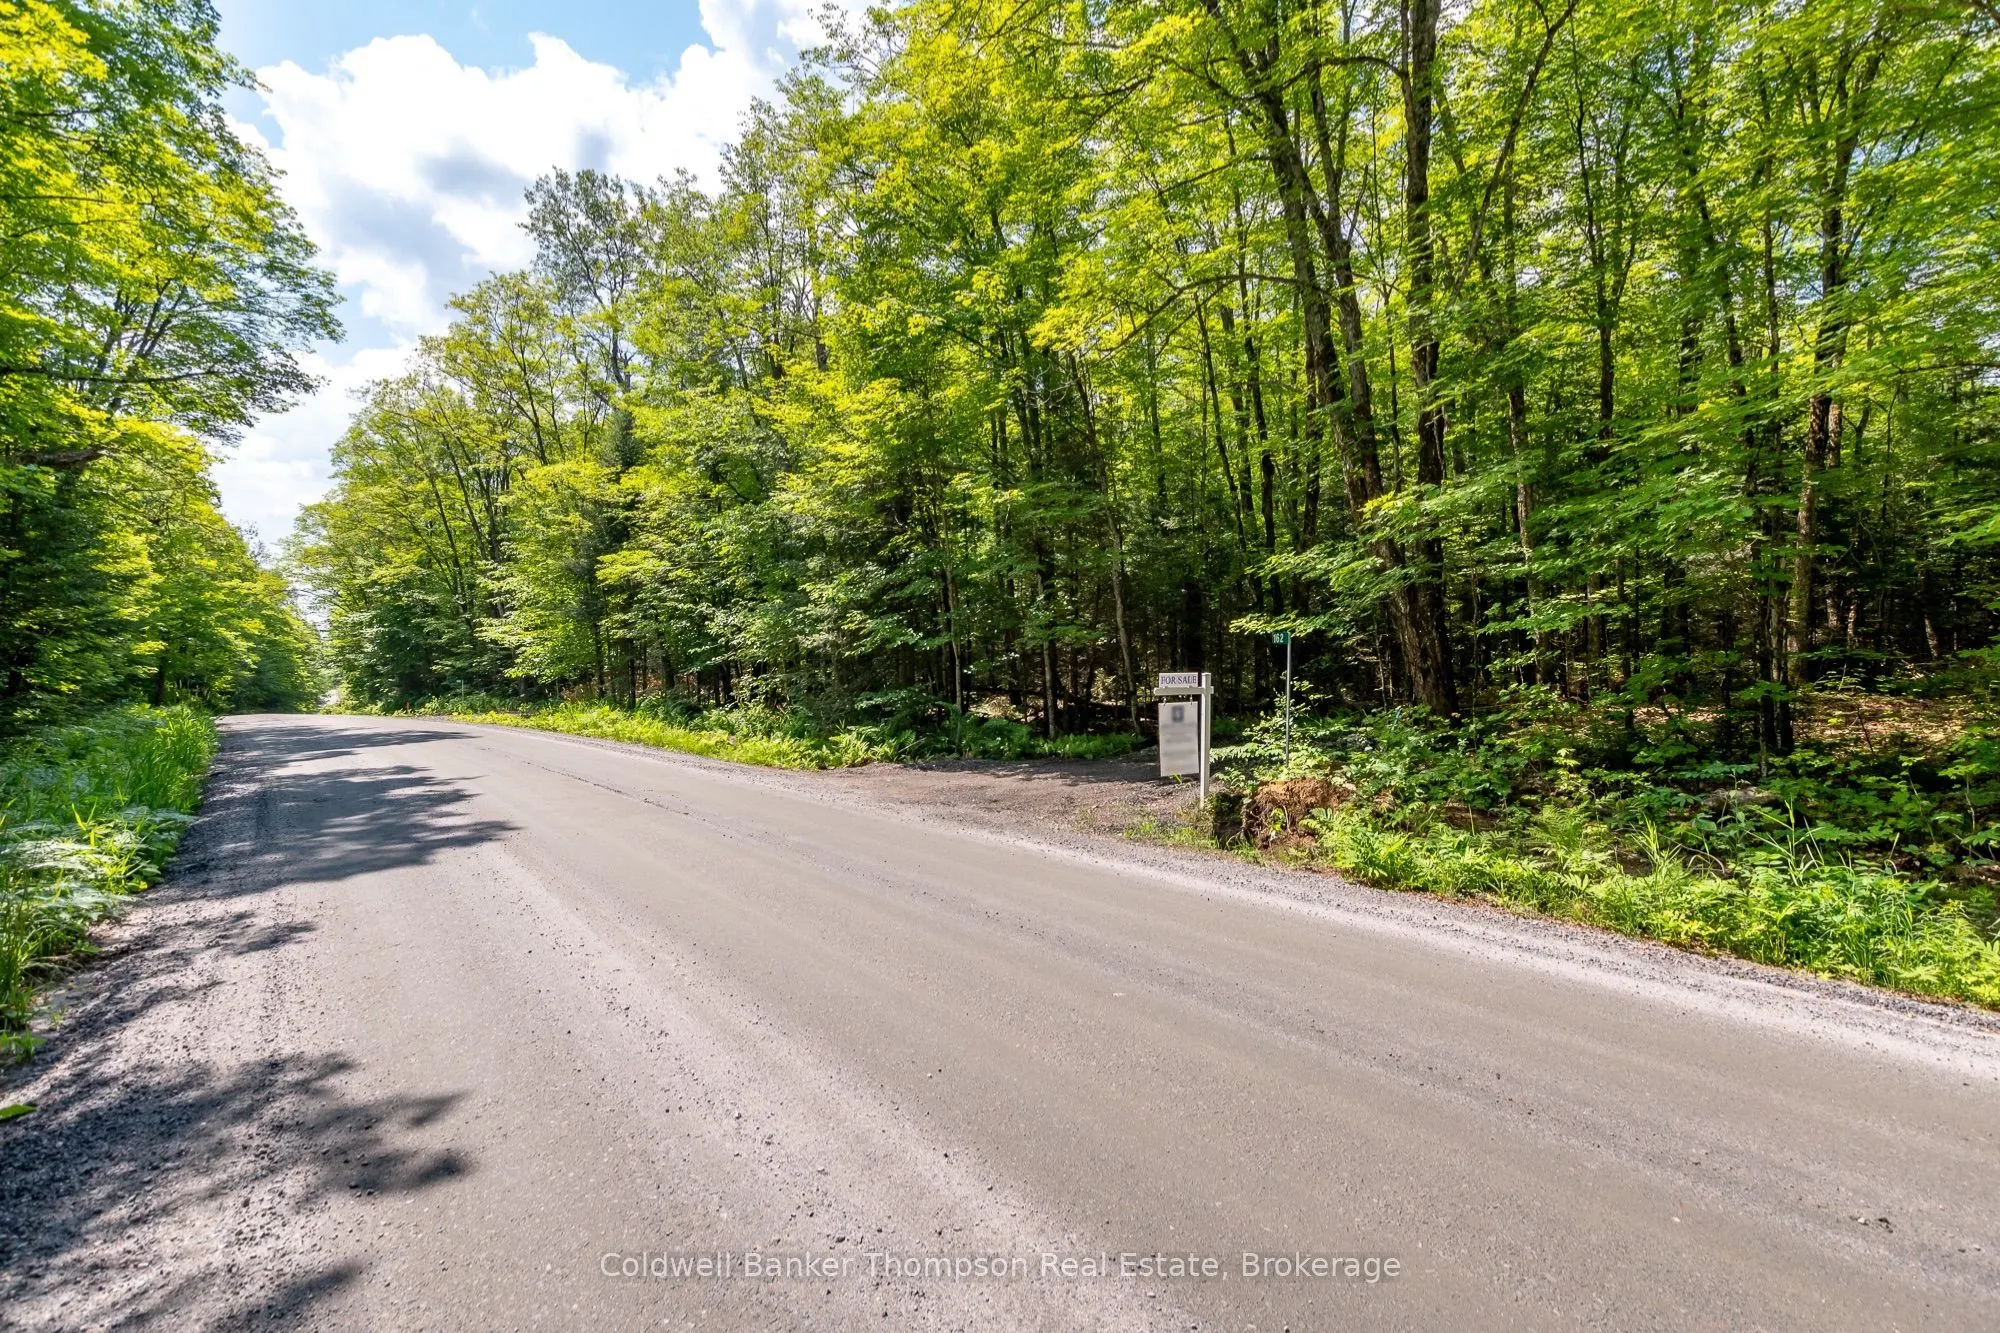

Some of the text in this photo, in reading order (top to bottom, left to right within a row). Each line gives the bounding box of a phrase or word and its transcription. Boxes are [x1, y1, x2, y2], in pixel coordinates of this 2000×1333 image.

[1272, 633, 1284, 643] 162
[1161, 675, 1197, 684] FOR SALE
